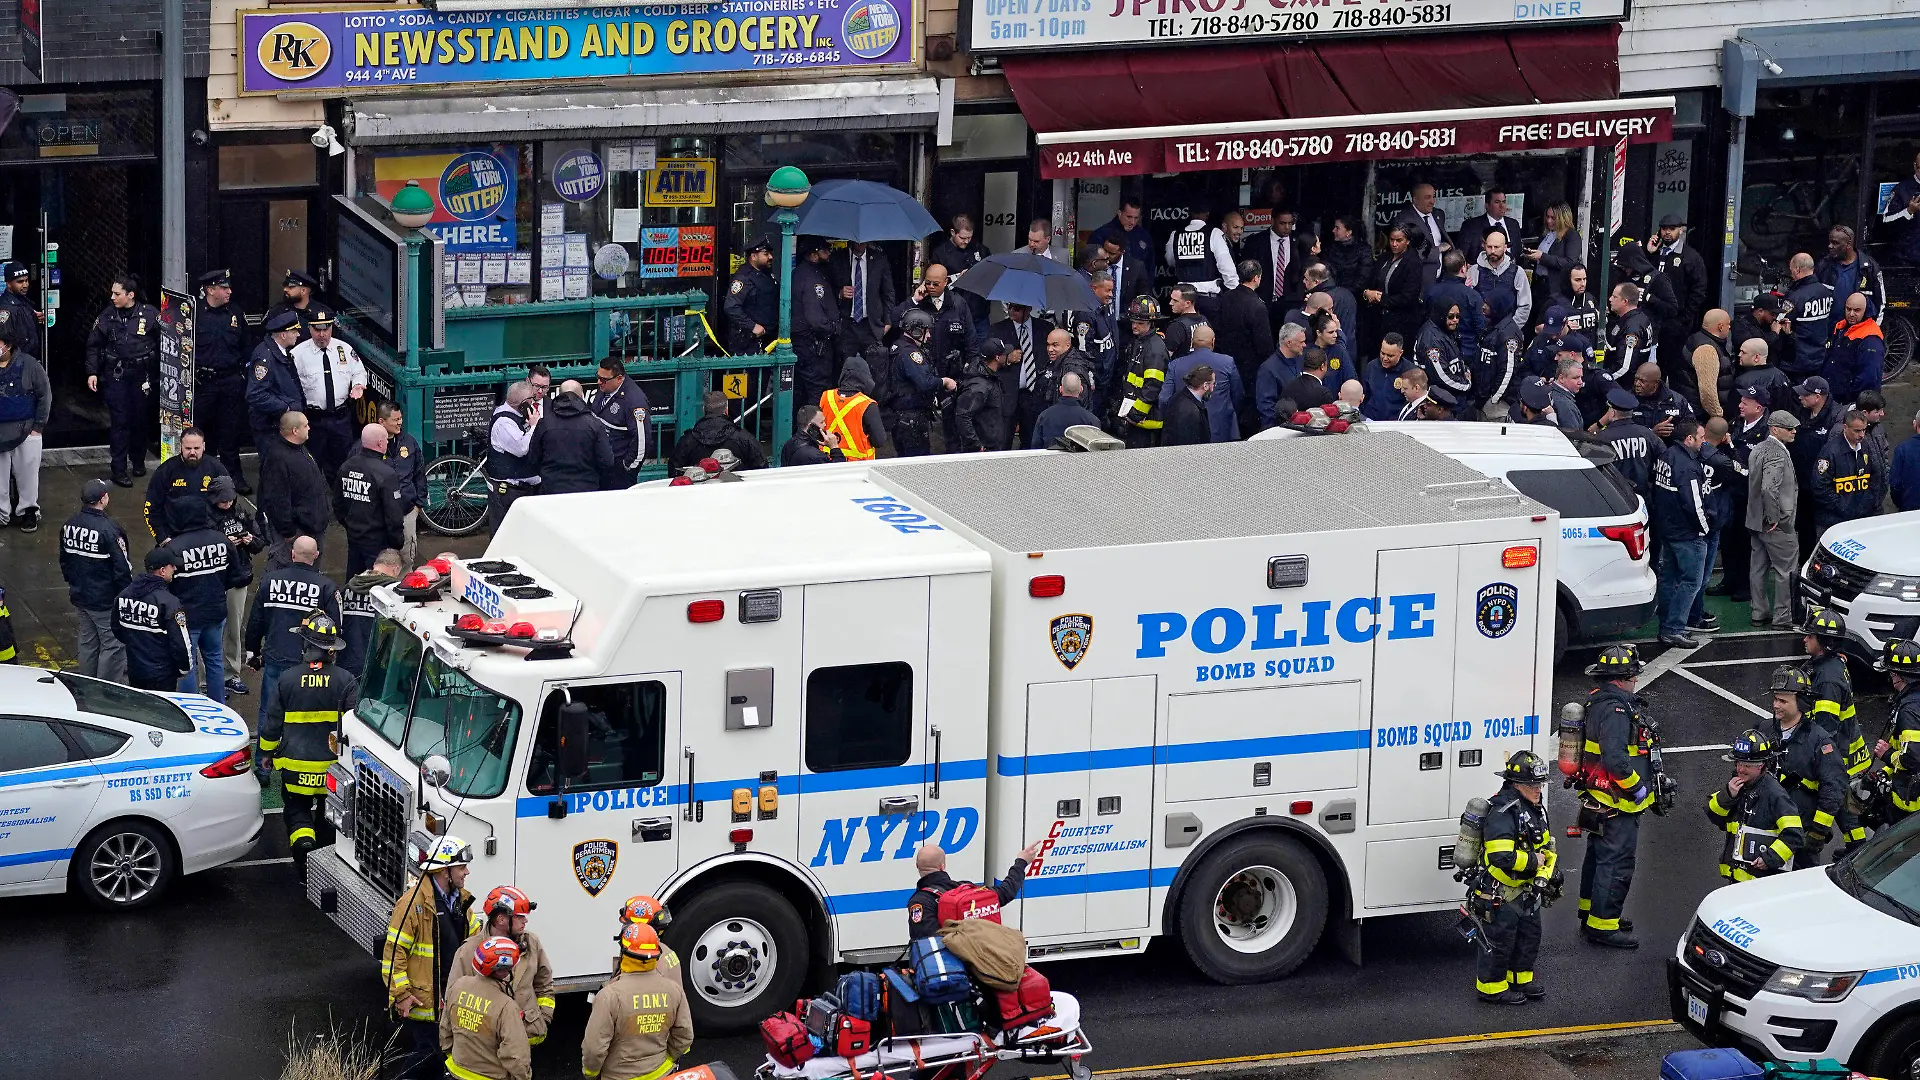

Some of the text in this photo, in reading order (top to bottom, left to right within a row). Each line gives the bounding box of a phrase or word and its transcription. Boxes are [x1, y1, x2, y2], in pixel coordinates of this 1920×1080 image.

[345, 0, 839, 28] LOTTO SODA CANDY CIGARETTES CIGAR COLD BEER STATIONERIES ETC
[868, 4, 889, 15] NEW
[1516, 2, 1581, 19] DINER
[871, 14, 895, 28] YORK
[990, 18, 1086, 40] 5am-10pm
[1148, 4, 1451, 37] TEL: 718-840-5780 718-840-5831
[355, 15, 834, 67] NEWSSTAND AND GROCERY INC.
[849, 27, 897, 50] LOTTERY
[269, 33, 319, 70] RK
[753, 51, 841, 65] 718-768-6845
[345, 69, 370, 82] 944
[392, 68, 416, 80] AVE
[40, 124, 99, 141] OPEN
[1499, 116, 1656, 143] FREE DELIVERY
[1175, 127, 1456, 163] TEL: 718-840-5780 718-840-5831
[471, 159, 494, 171] NEW
[577, 156, 594, 165] NEW
[1056, 149, 1132, 169] 942 4th Ave
[473, 170, 502, 188] YORK
[578, 163, 598, 177] YORK
[559, 175, 601, 195] LOTTERY
[656, 170, 706, 192] ATM
[1657, 180, 1687, 193] 940
[446, 184, 504, 213] LOTTERY
[984, 212, 1015, 226] 942
[1150, 207, 1189, 220] TACOS
[1245, 213, 1271, 223] Open
[443, 225, 508, 245] HERE.
[1178, 232, 1204, 246] NYPD
[649, 246, 713, 264] 106 302
[1178, 245, 1205, 256] POLICE
[646, 266, 674, 274] MILLION
[681, 265, 710, 273] MILLION
[1803, 296, 1834, 317] POLICE
[371, 374, 391, 400] Station
[1611, 437, 1647, 460] NYPD
[342, 477, 371, 495] FDNY
[63, 525, 99, 543] NYPD
[1562, 527, 1583, 540] 5065
[63, 538, 99, 552] POLICE
[182, 543, 227, 563] NYPD
[1829, 541, 1860, 561] POLICE
[184, 556, 228, 571] POLICE
[270, 579, 320, 598] NYPD
[470, 575, 500, 605] NYPD
[1479, 585, 1516, 603] POLICE
[118, 597, 159, 619] NYPD
[270, 593, 319, 607] POLICE
[344, 601, 375, 612] POLIC
[465, 585, 505, 619] POLICE
[1487, 598, 1507, 609] NYPD
[119, 612, 159, 627] POLICE
[1052, 622, 1091, 634] DEPARTMENT
[1060, 616, 1083, 625] POLICE
[1136, 593, 1436, 659] POLICE
[1478, 618, 1514, 637] BOMB SQUAD
[1196, 656, 1335, 683] BOMB SQUAD
[301, 675, 330, 688] FDNY
[1377, 726, 1418, 748] BOMB
[1423, 721, 1472, 747] SQUAD
[1484, 717, 1516, 739] 7091
[107, 772, 193, 789] SCHOOL SAFETY
[130, 789, 142, 802] BS
[145, 787, 161, 801] SSD
[575, 786, 667, 813] POLICE
[809, 807, 979, 867] NYPD
[1048, 820, 1114, 839] COURTESY
[575, 848, 615, 860] DEPARTMENT
[584, 842, 608, 850] POLICE
[1037, 839, 1148, 858] PROFESSIONALISM
[1026, 858, 1086, 877] RESPECT
[964, 903, 999, 919] FDNY
[1712, 919, 1754, 949] POLICE
[1729, 916, 1761, 935] NYPD
[457, 1007, 484, 1024] RESCUE
[637, 1013, 666, 1025] RESCUE
[1690, 1001, 1706, 1020] 5010
[459, 1018, 478, 1033] MEDIC
[640, 1023, 661, 1034] MEDIC
